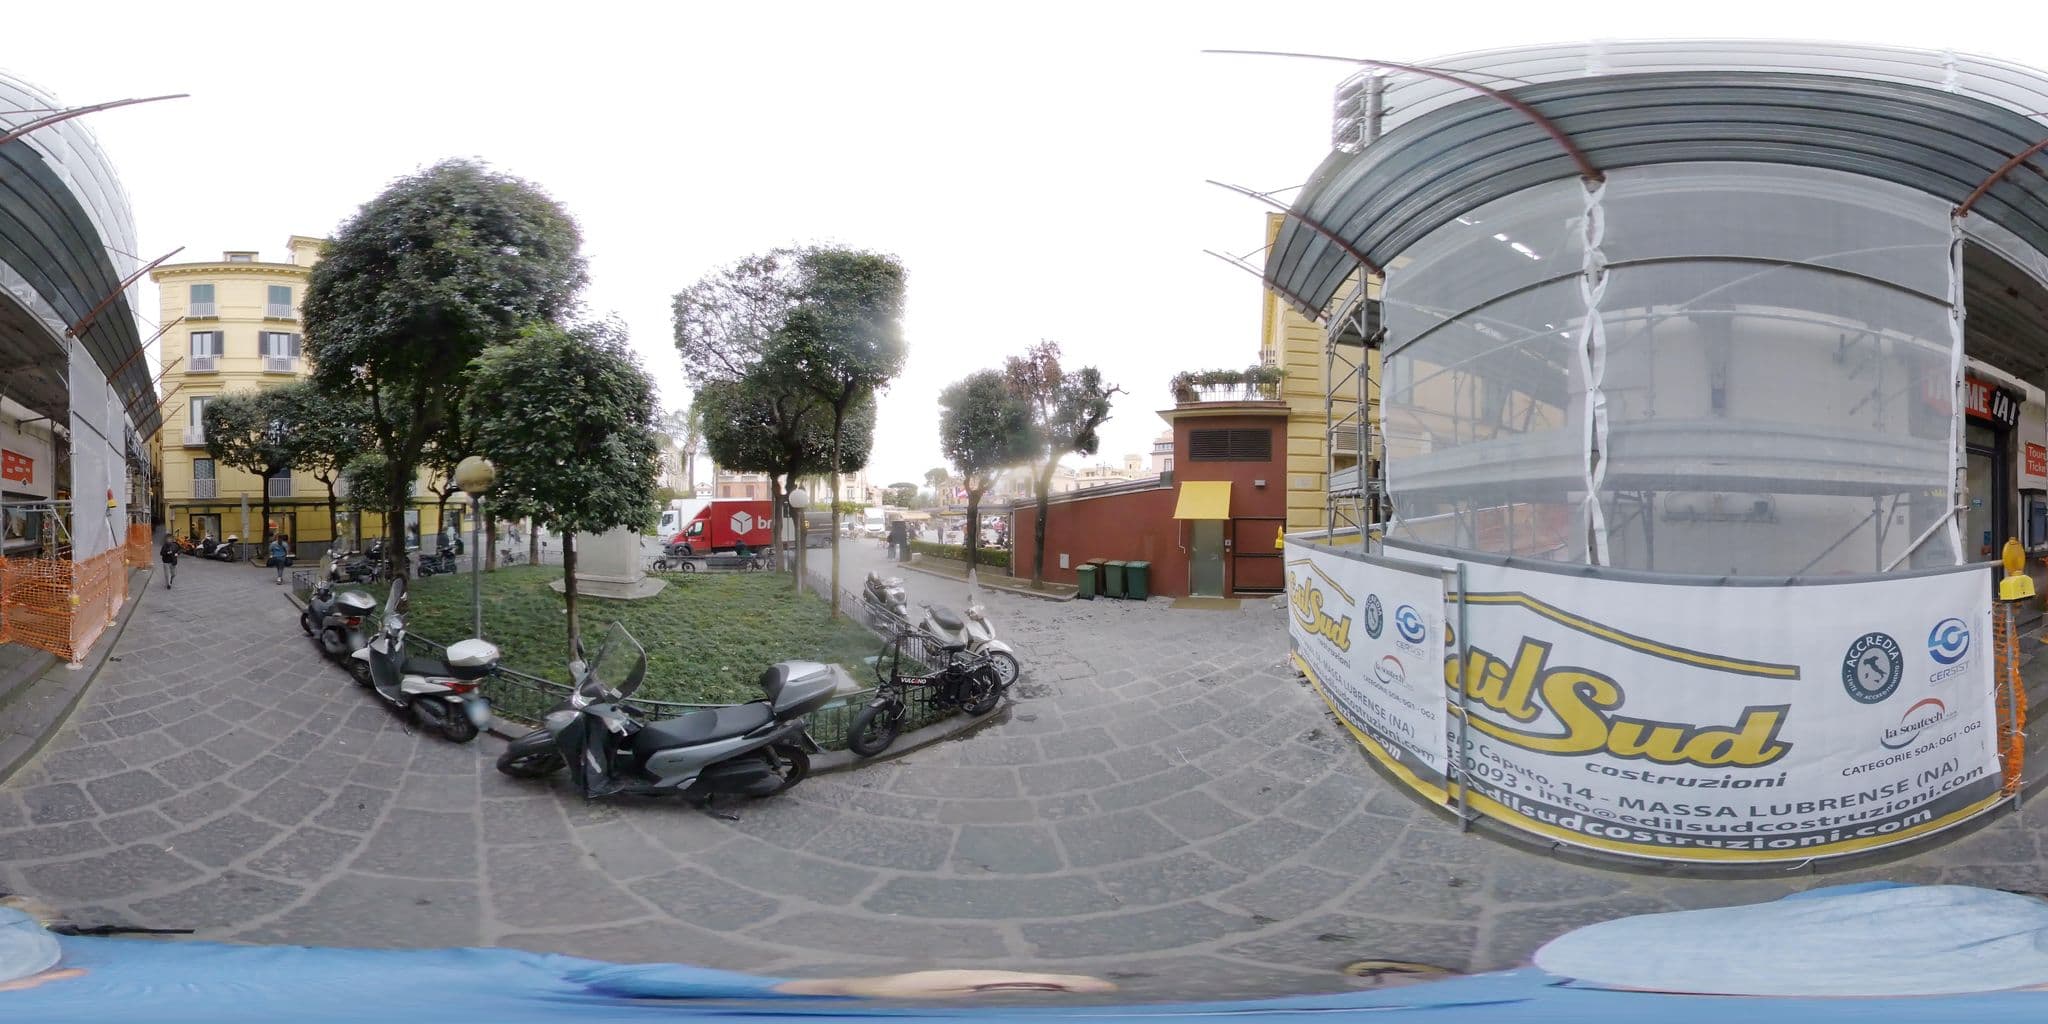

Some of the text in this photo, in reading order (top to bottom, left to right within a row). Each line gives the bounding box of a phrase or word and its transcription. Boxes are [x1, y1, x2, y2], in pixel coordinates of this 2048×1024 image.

[2027, 460, 2047, 474] Ticke
[757, 516, 773, 529] br
[1846, 635, 1900, 668] ACCREDIA
[1929, 661, 1970, 683] CERSIST
[1389, 713, 1415, 739] (NA)
[1885, 729, 1897, 739] la
[1842, 751, 1912, 777] CATEGORIE
[1915, 741, 1938, 756] SOA:
[1939, 731, 1958, 746] OG1
[1963, 720, 1982, 734] OG2
[1480, 744, 1555, 789] Caputo,
[1562, 782, 1594, 801] 14
[1618, 796, 1738, 818] MASSA
[1750, 779, 1910, 817] LUBRENSE
[1917, 757, 1960, 787] (NA)
[1585, 762, 1787, 789] costruzioni
[1539, 765, 1984, 833] info@edilsudcostruzioni.com
